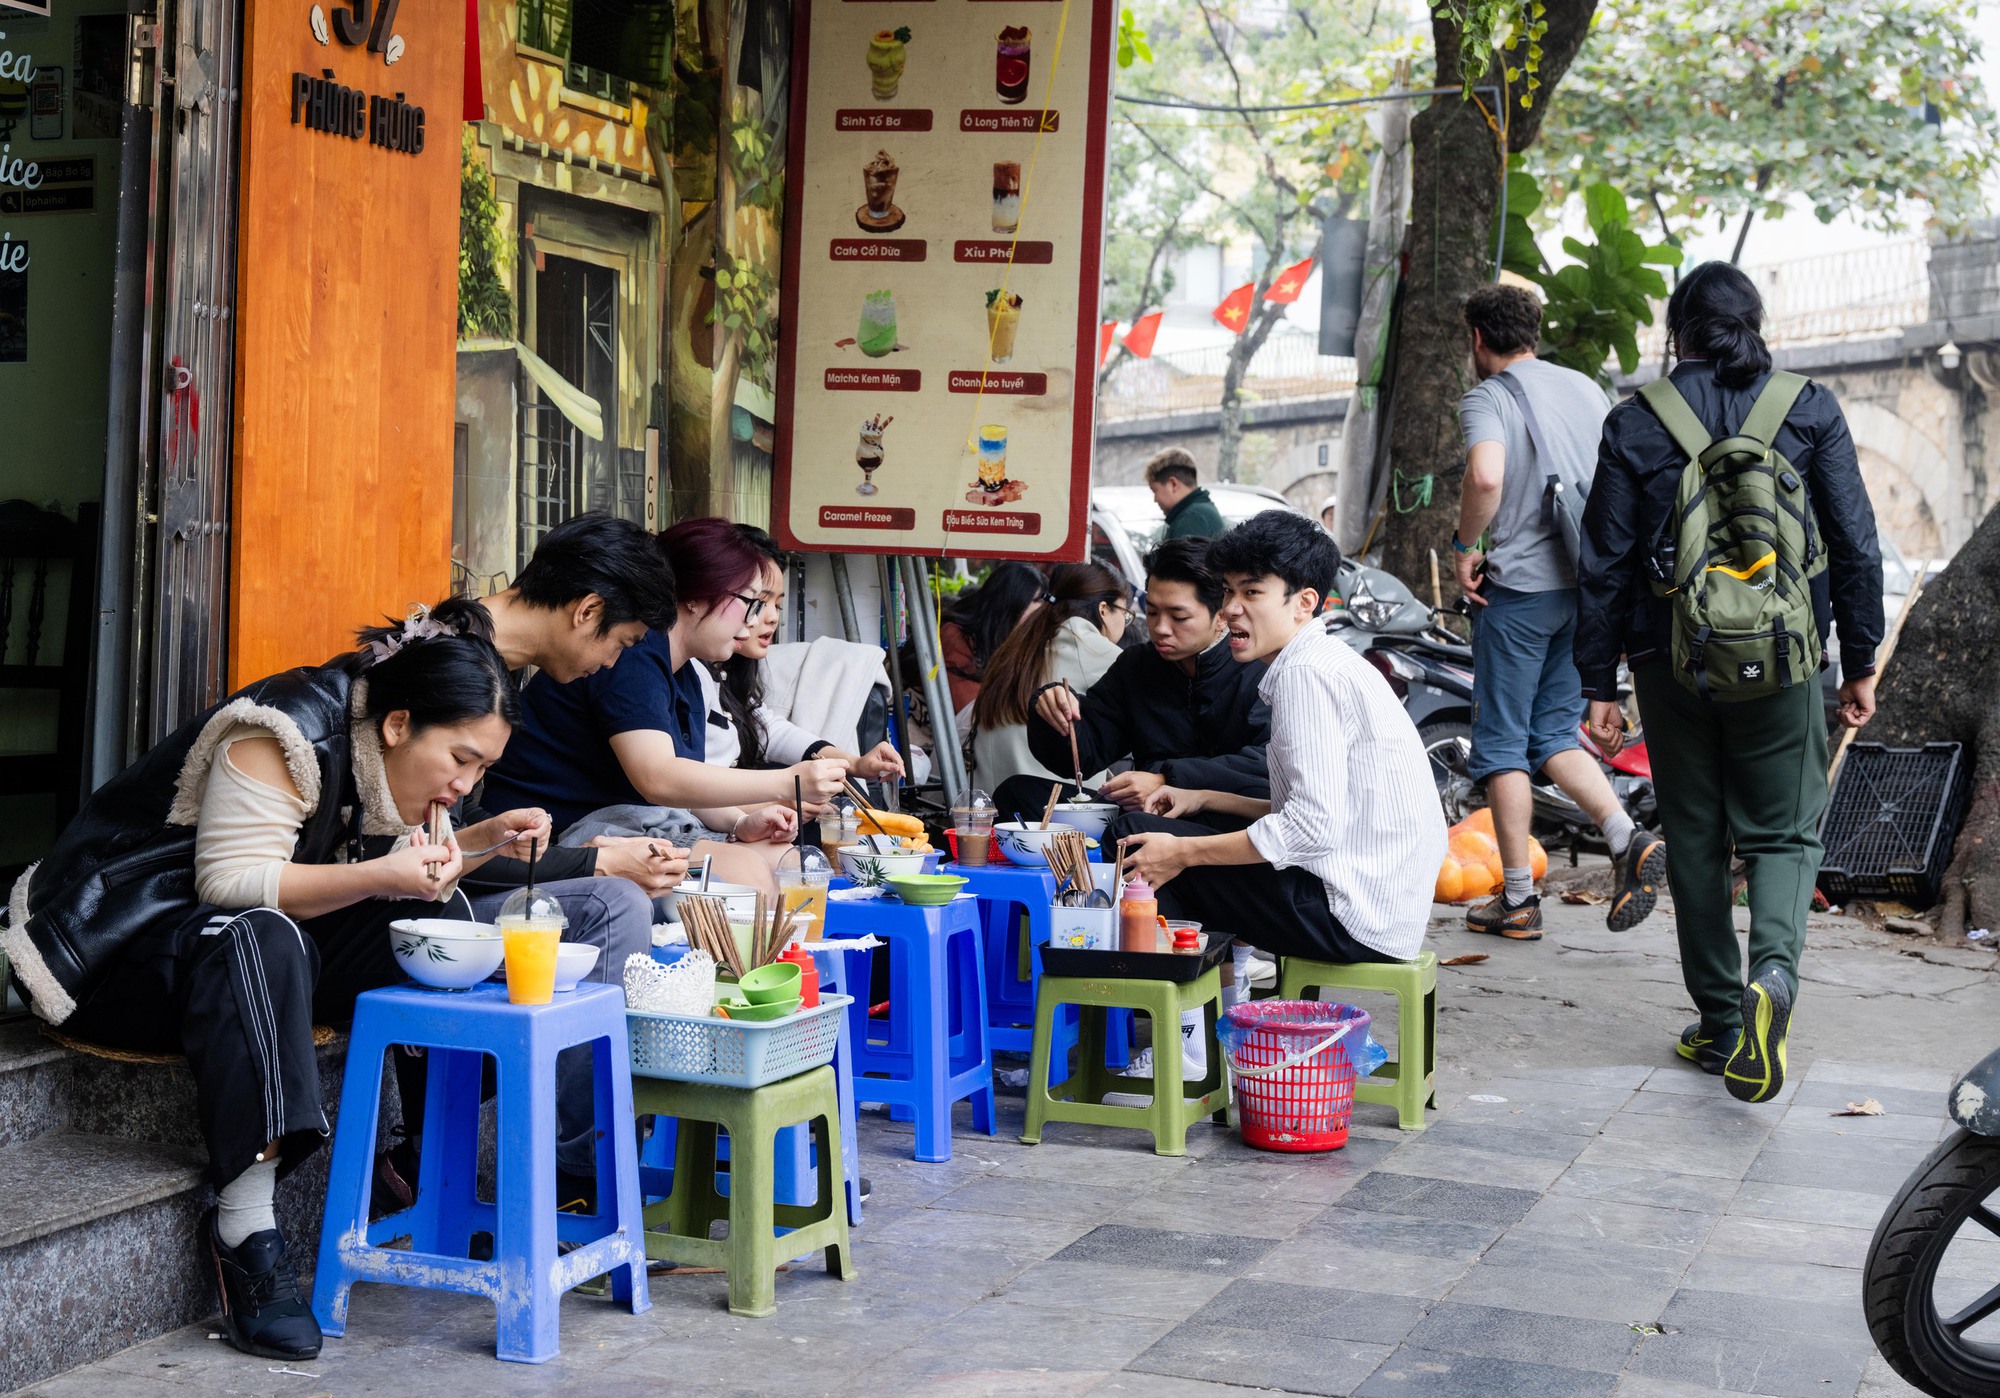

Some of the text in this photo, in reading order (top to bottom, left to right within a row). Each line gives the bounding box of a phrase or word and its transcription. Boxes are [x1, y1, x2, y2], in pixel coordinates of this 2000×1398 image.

[0, 31, 37, 83] ea
[842, 114, 901, 126] Sinh Tố Bơ
[964, 115, 973, 127] Ô
[975, 117, 998, 129] Long
[1001, 116, 1020, 127] Tiên
[835, 244, 900, 257] Cafe Cốt Dừa
[827, 373, 859, 383] Matcha
[861, 374, 880, 384] Kem
[952, 377, 1024, 390] Chanh Leo tuyết
[823, 511, 892, 522] Caramel Frezee
[990, 516, 1005, 526] Kem
